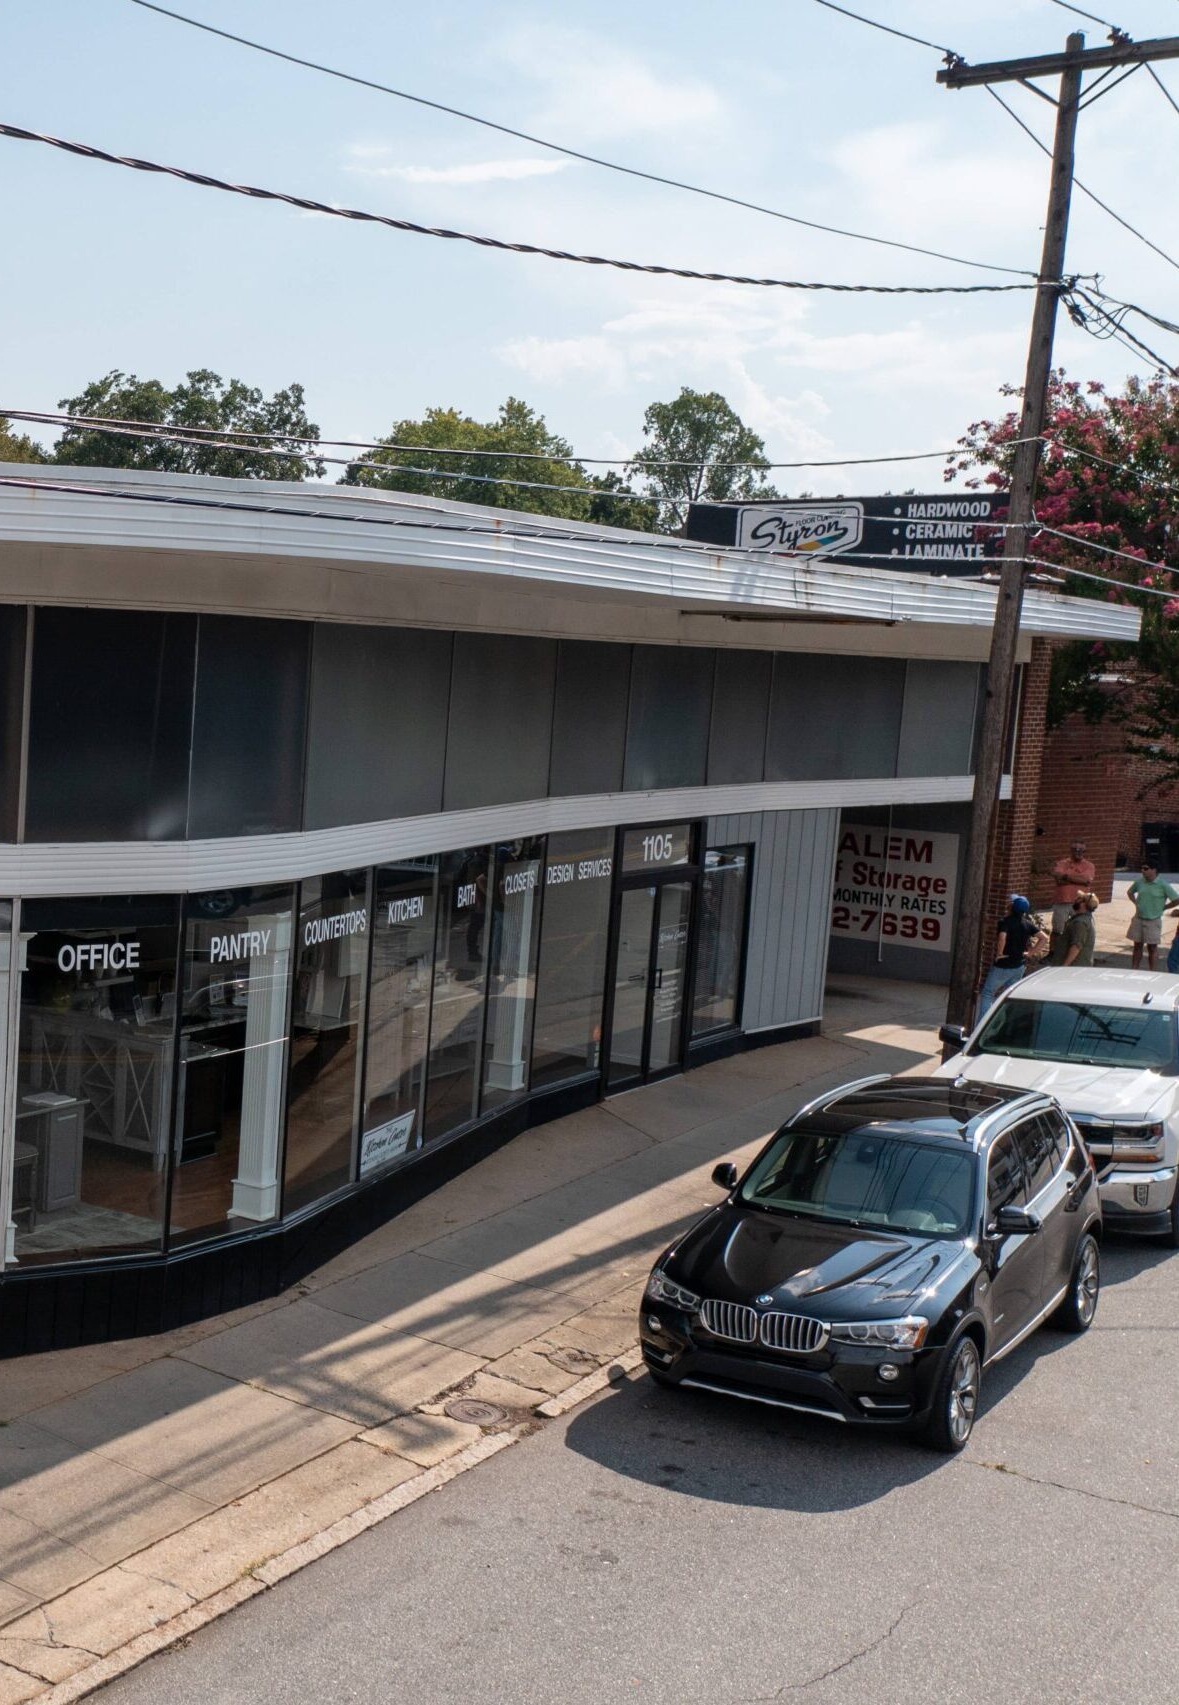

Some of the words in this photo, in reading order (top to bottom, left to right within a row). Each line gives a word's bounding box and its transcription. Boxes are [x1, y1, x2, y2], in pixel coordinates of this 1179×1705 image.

[907, 502, 991, 518] HARDWOOD
[750, 517, 849, 551] Styron
[905, 522, 973, 539] CERAMIC
[905, 543, 985, 559] LAMINATE
[641, 834, 673, 862] 1105
[838, 832, 934, 864] ALEM
[504, 869, 535, 896] CLOSETS
[546, 863, 574, 885] DESIGN
[577, 858, 612, 880] SERVICES
[852, 861, 947, 897] Storage
[388, 895, 424, 925] KITCHEN
[456, 883, 476, 909] BATH
[901, 896, 947, 916] RATES
[304, 909, 367, 947] COUNTERTOPS
[832, 906, 941, 941] 2-7639
[57, 942, 141, 972] OFFICE
[210, 930, 271, 964] PANTRY
